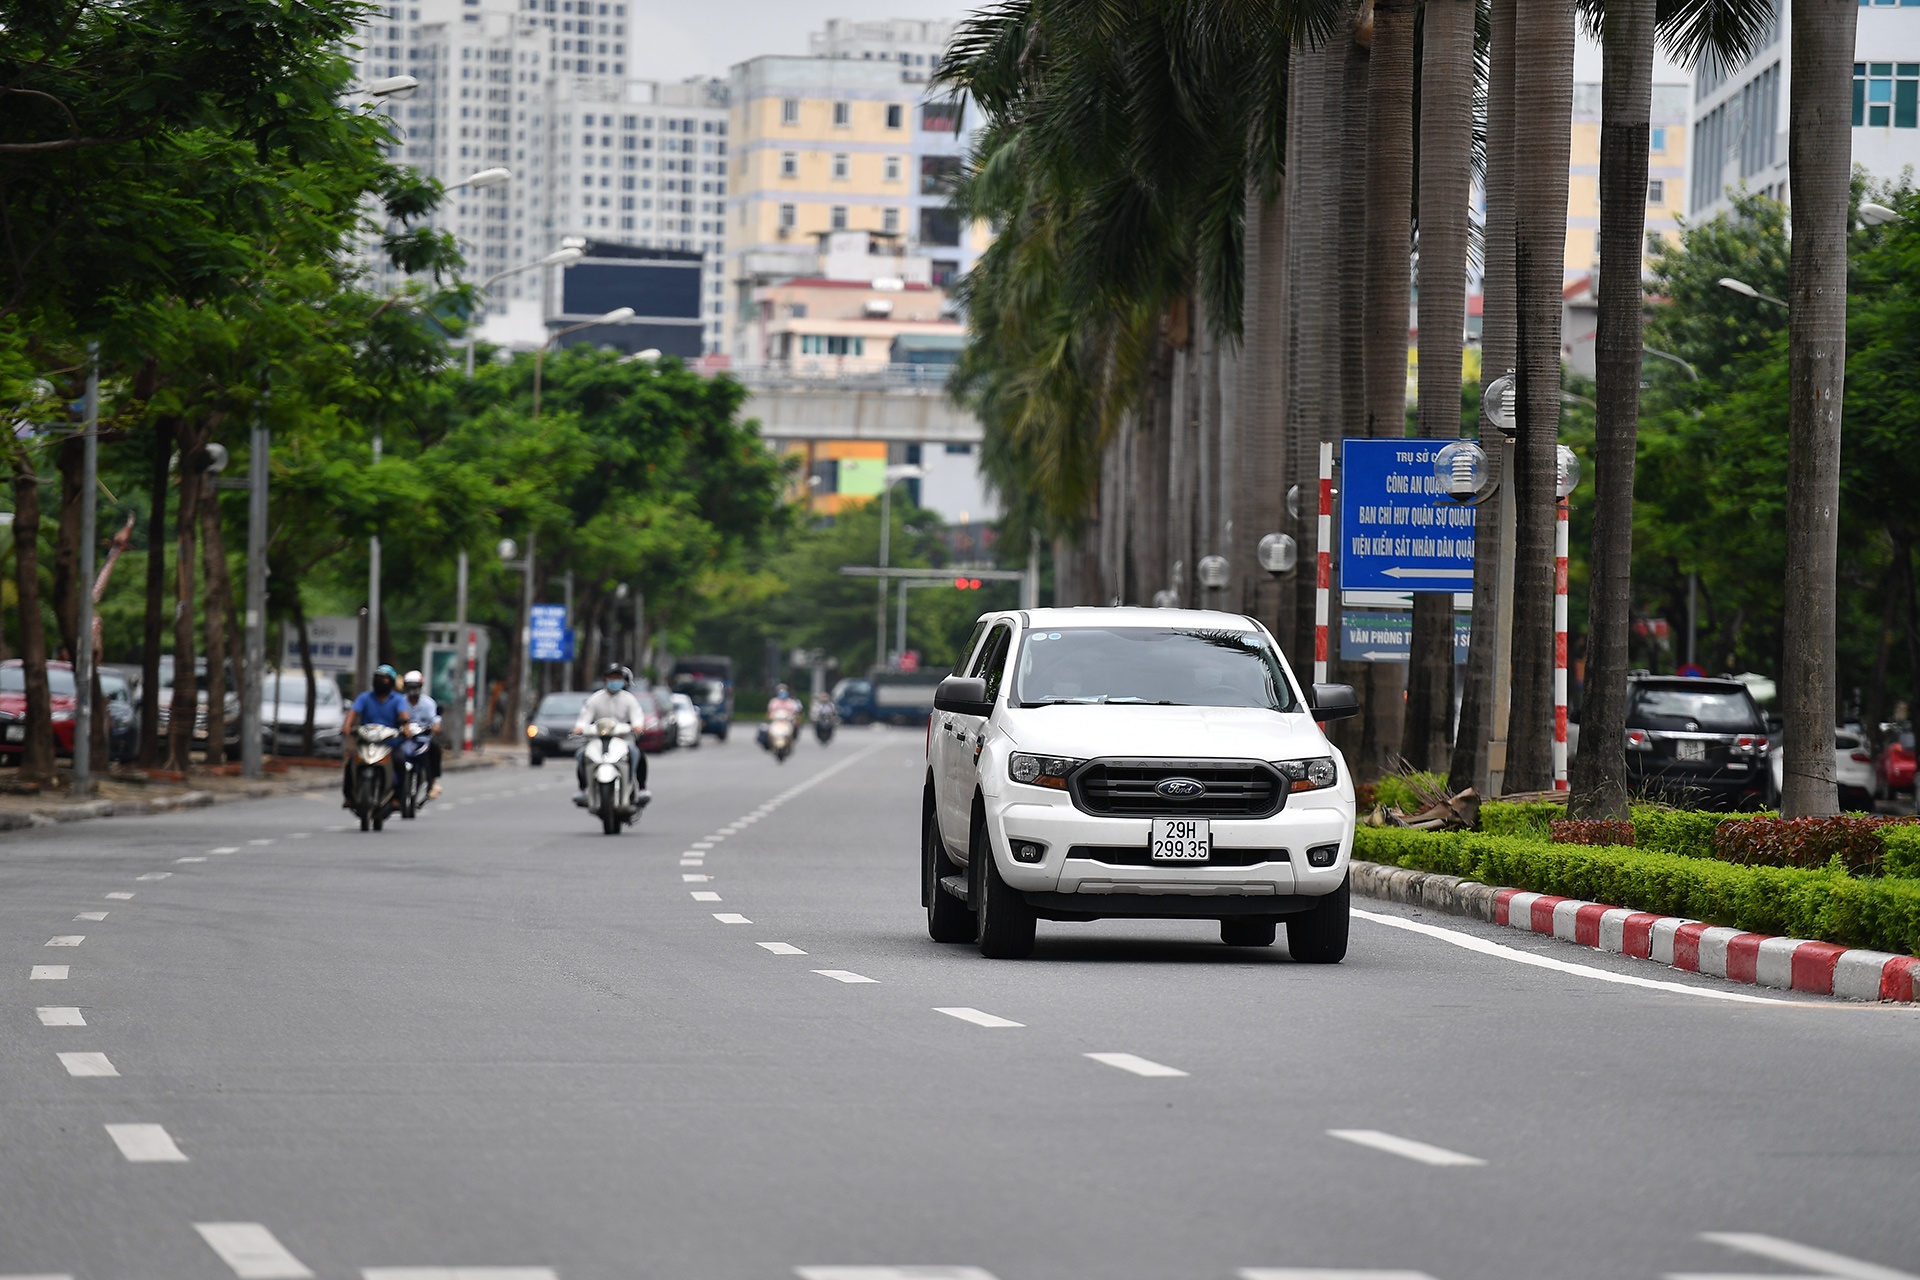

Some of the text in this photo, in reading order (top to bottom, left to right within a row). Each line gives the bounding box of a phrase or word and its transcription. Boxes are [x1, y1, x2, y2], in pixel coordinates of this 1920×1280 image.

[1396, 451, 1414, 466] TRỤ
[1416, 448, 1430, 463] SỞ
[1386, 471, 1409, 494] CÔNG
[1410, 475, 1423, 494] AN
[1359, 506, 1377, 525] BAN
[1378, 500, 1392, 525] CHỈ
[1394, 506, 1410, 525] HUY
[1435, 506, 1448, 529] SỰ
[1448, 505, 1471, 529] QUẬN
[1352, 533, 1371, 559] VIỆN
[1372, 530, 1393, 556] KIỂM
[1394, 534, 1411, 557] SÁT
[1412, 535, 1435, 557] NHÂN
[1437, 535, 1454, 558] DÂN
[1350, 627, 1369, 644] VĂN
[1370, 628, 1403, 645] PHÒNG
[1112, 760, 1248, 769] RANGER
[1167, 782, 1193, 794] Ford
[1166, 821, 1196, 839] 29H
[1154, 840, 1207, 858] 299.35
